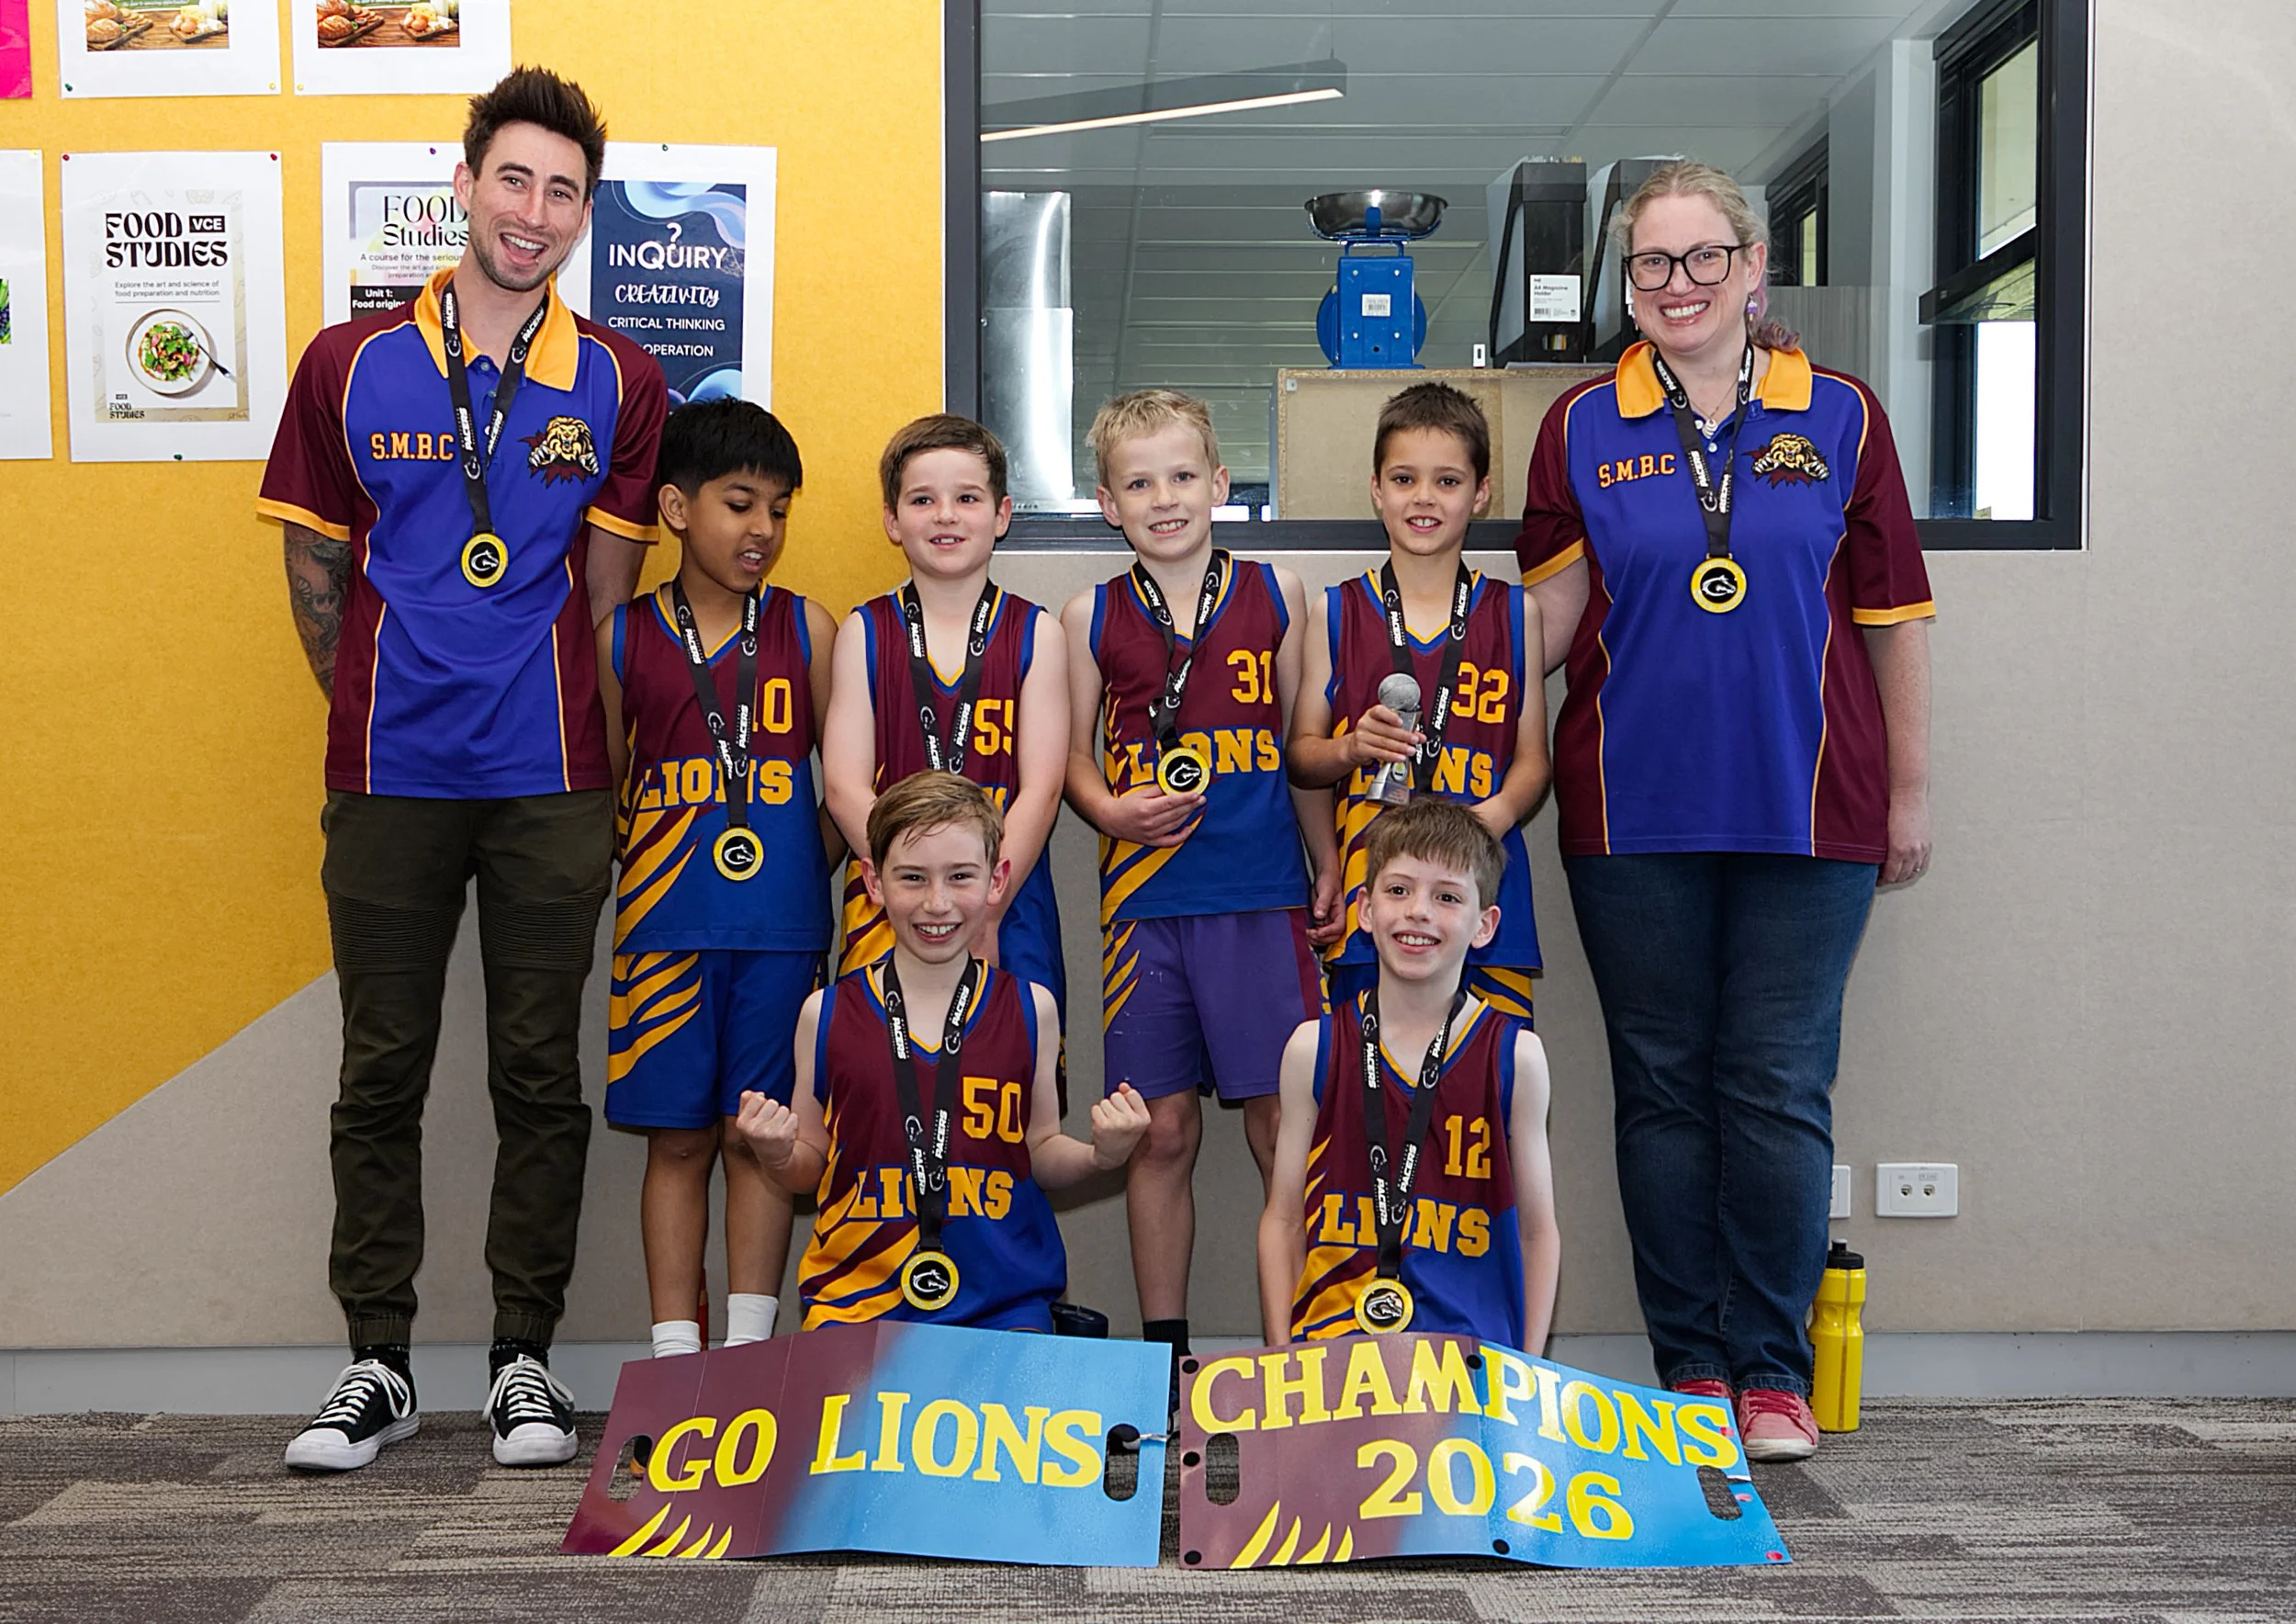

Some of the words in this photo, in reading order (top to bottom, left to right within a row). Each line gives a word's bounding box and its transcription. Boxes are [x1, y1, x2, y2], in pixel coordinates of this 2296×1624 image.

[384, 196, 468, 223] FOOD
[106, 212, 183, 239] FOOD
[192, 218, 222, 231] VCE
[382, 223, 469, 246] Studies
[106, 241, 228, 268] STUDIES
[400, 253, 413, 261] for
[415, 253, 430, 261] the
[609, 241, 728, 270] INQUIRY
[115, 281, 141, 289] Explore
[133, 289, 174, 299] preparation
[365, 288, 384, 298] Unit
[386, 288, 393, 298] 1:
[352, 299, 375, 309] Food
[608, 316, 663, 330] CRITICAL
[666, 318, 726, 331] THINKING
[643, 344, 714, 356] OPERATION
[109, 402, 132, 411] FOOD
[109, 411, 145, 419] STUDIES
[370, 432, 456, 461] S.M.B.C
[1597, 453, 1676, 489] S.M.B.C
[1227, 649, 1274, 705] 31
[1450, 661, 1510, 724] 32
[928, 734, 941, 771] PACER
[1127, 728, 1281, 786] LONS
[962, 1076, 1025, 1144] 50
[1443, 1114, 1492, 1179] 12
[1317, 1193, 1491, 1258] LINS
[1190, 1338, 1740, 1470] CHAMPIONS
[647, 1407, 779, 1493] GO
[809, 1391, 1104, 1489] LIONS
[1356, 1438, 1635, 1540] 2026
